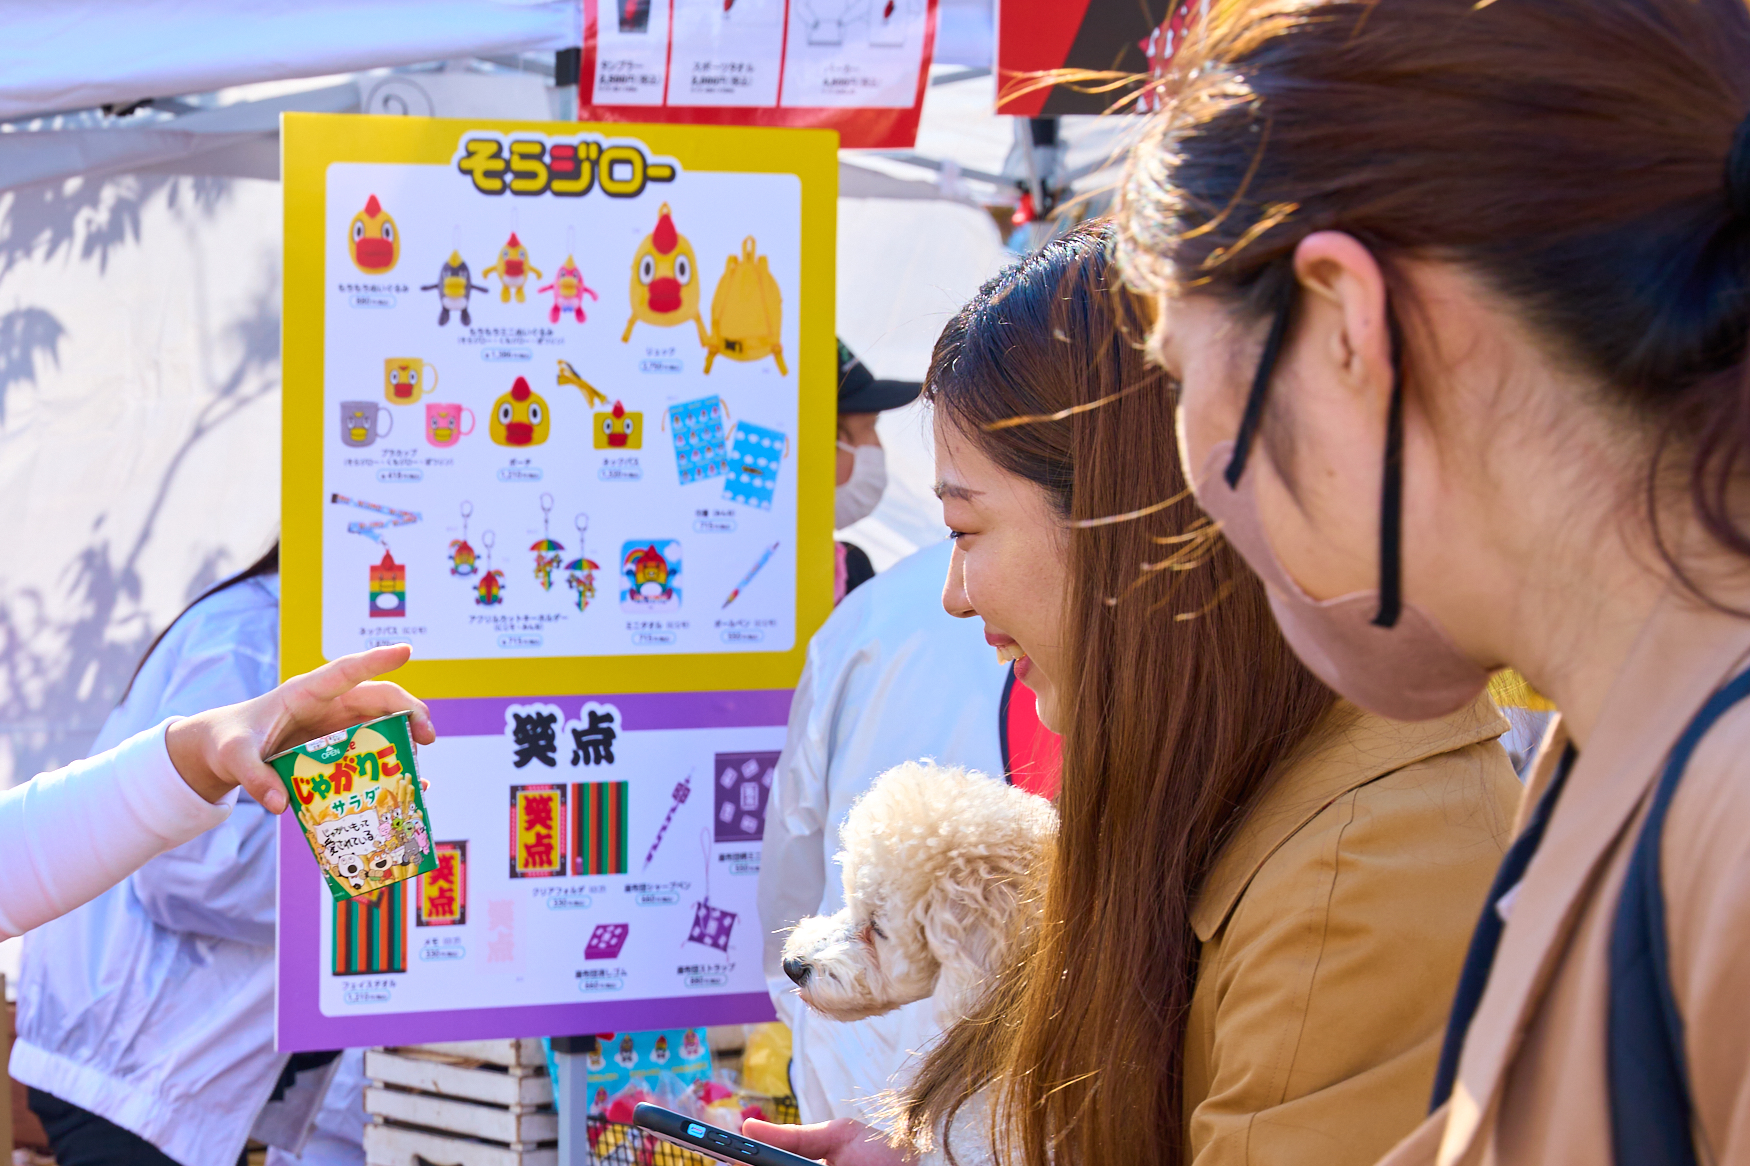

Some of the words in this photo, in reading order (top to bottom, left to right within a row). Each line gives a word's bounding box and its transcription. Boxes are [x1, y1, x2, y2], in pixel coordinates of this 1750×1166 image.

[458, 138, 676, 199] そらジロー
[321, 747, 341, 760] OPEN
[513, 710, 616, 769] 笑点
[291, 744, 403, 806] じゃがりこ
[331, 786, 382, 816] サラダ
[324, 830, 374, 857] 愛されている
